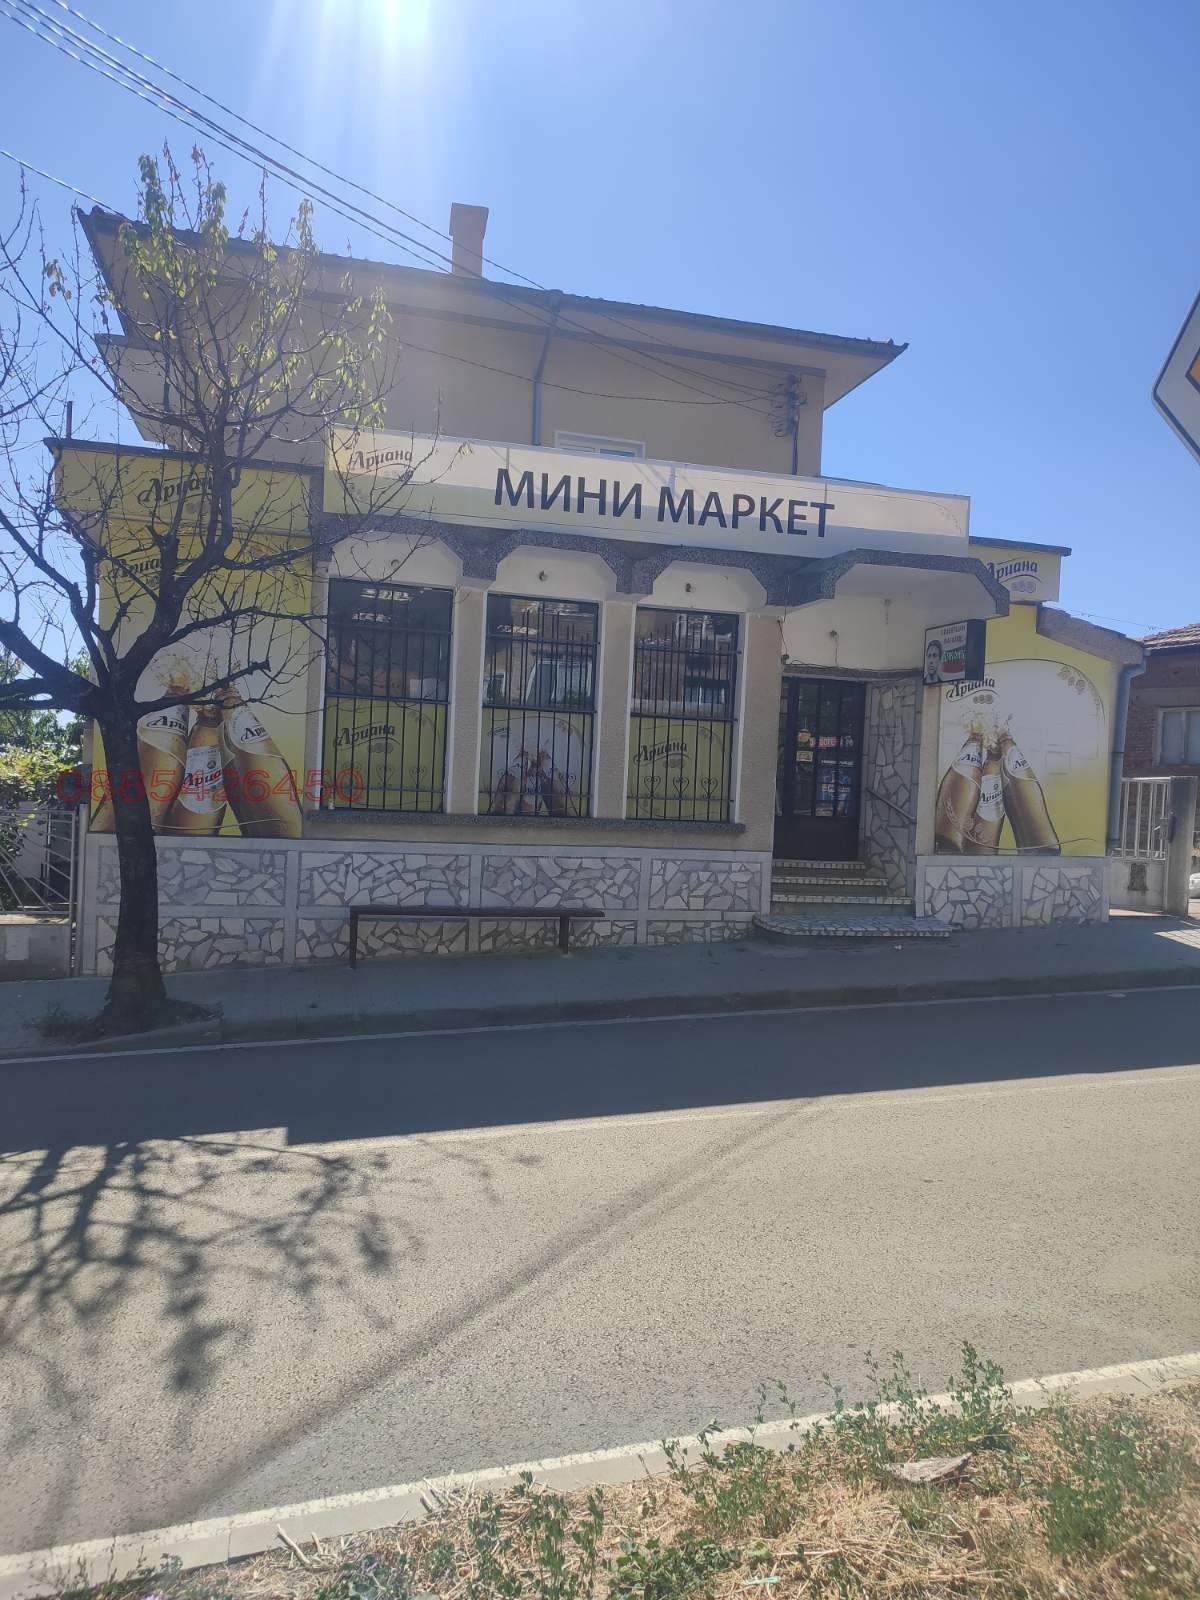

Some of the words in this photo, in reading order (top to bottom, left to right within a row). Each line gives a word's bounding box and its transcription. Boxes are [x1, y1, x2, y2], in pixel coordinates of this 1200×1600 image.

[346, 449, 413, 472] Ариана
[494, 468, 642, 519] МИНИ
[657, 486, 835, 537] МАРКЕТ
[334, 724, 395, 748] Ариана
